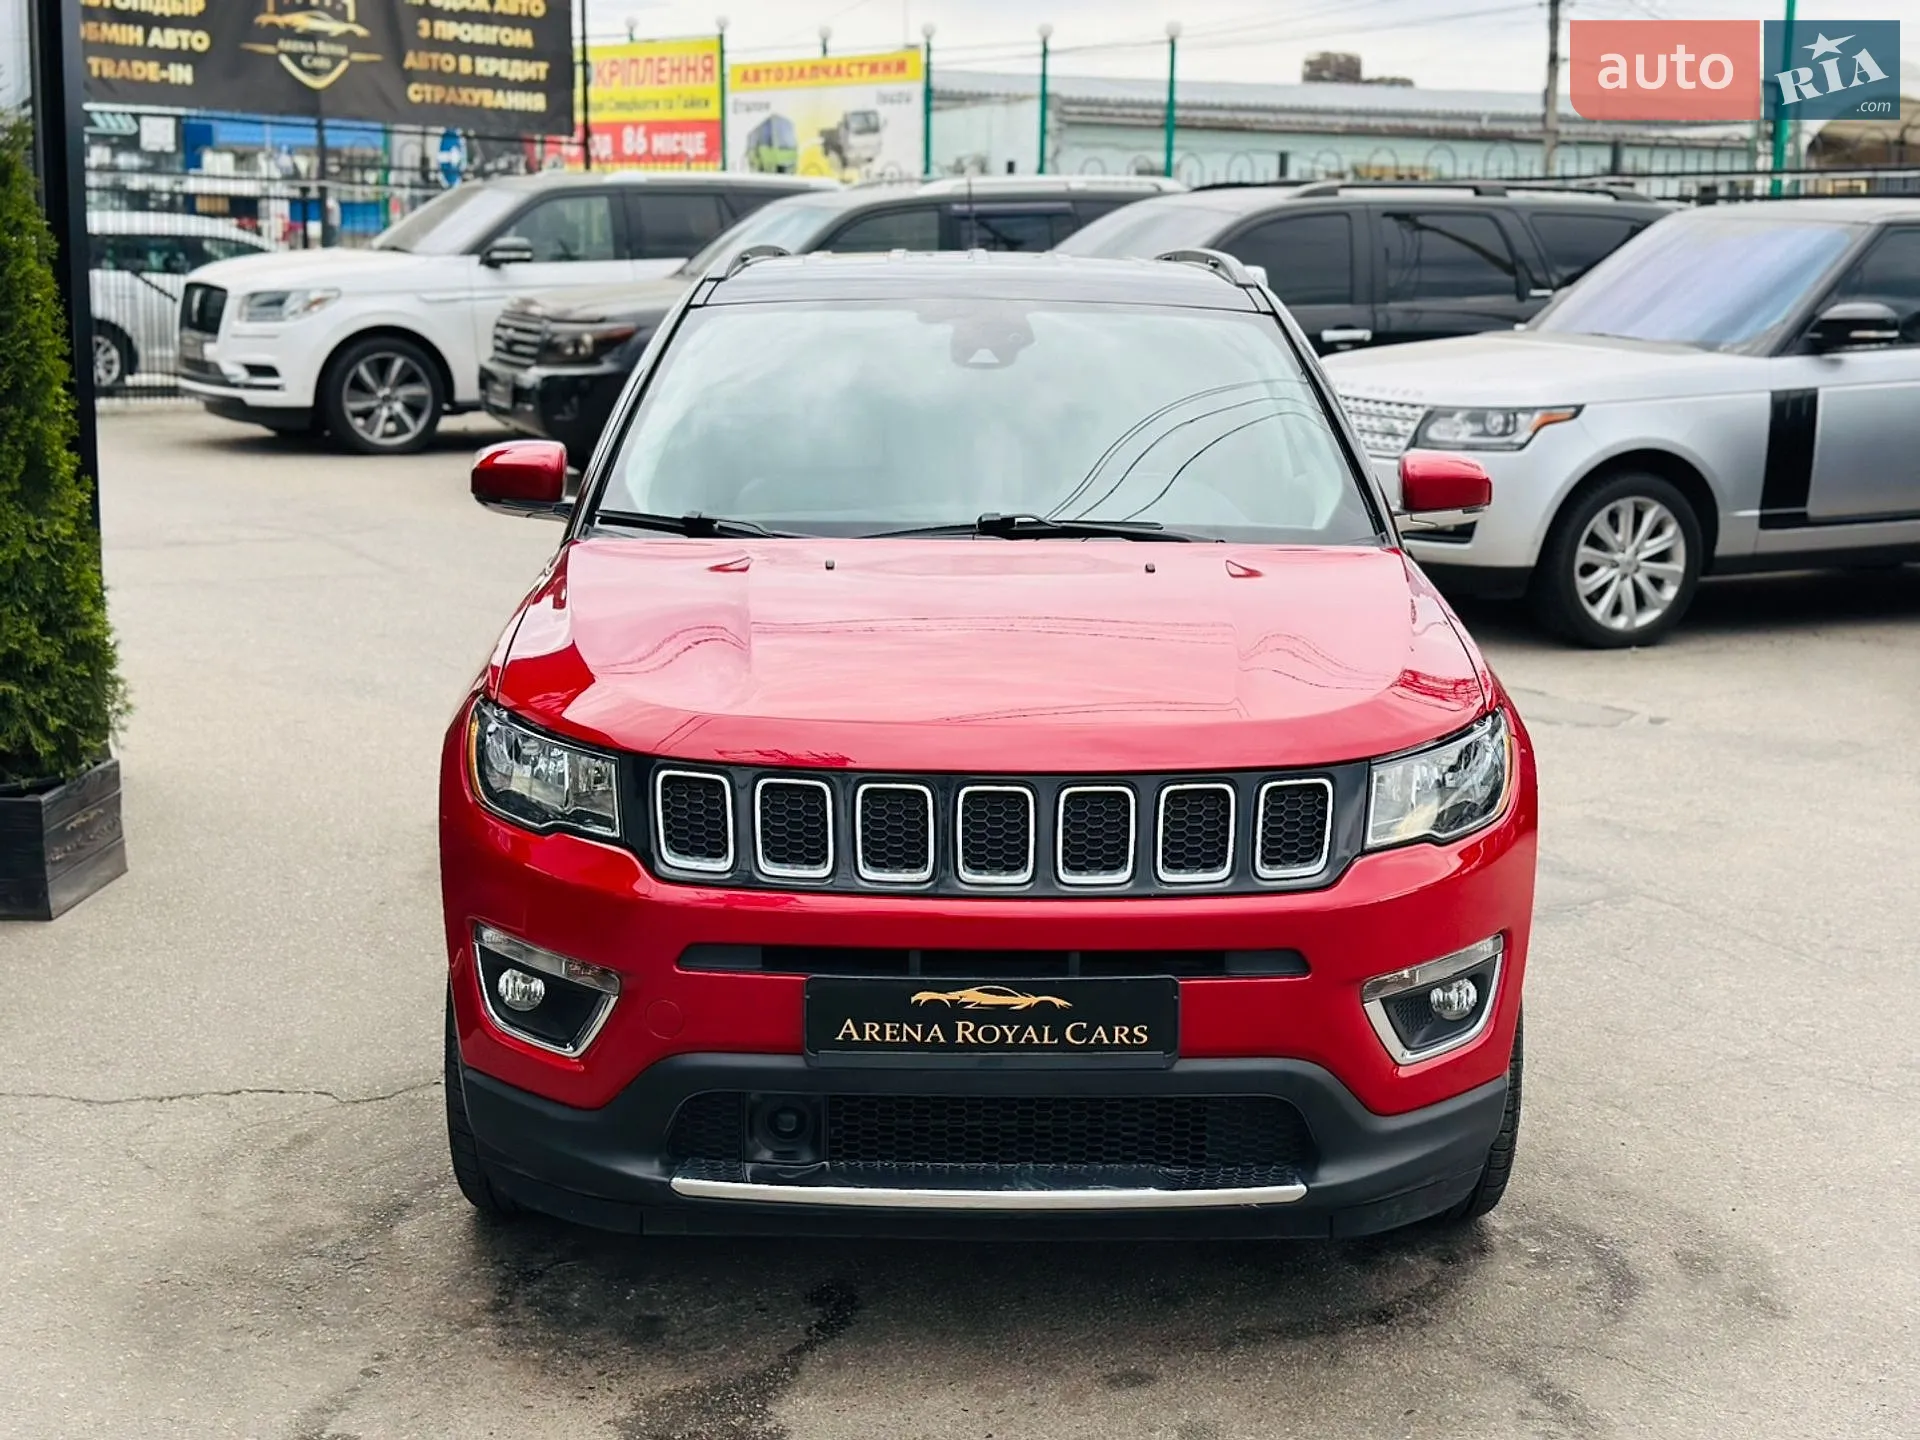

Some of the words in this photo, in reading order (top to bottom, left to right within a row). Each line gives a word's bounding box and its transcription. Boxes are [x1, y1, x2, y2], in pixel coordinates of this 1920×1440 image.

[80, 21, 144, 47] БМІН
[147, 26, 211, 52] АВТО
[433, 20, 534, 48] ПРОБІГОМ
[87, 56, 194, 86] TRADE-IN
[403, 50, 457, 73] АВТО
[458, 54, 473, 75] В
[475, 56, 550, 82] КРЕДИТ
[741, 58, 907, 85] АВТОЗАПЧАСТИНИ
[407, 82, 548, 112] СТРАХУВАННЯ
[622, 125, 648, 155] 86
[652, 131, 708, 159] МІСЦЕ
[835, 1018, 945, 1043] ARENA
[955, 1020, 1059, 1045] ROYAL
[1065, 1021, 1149, 1045] CARS
